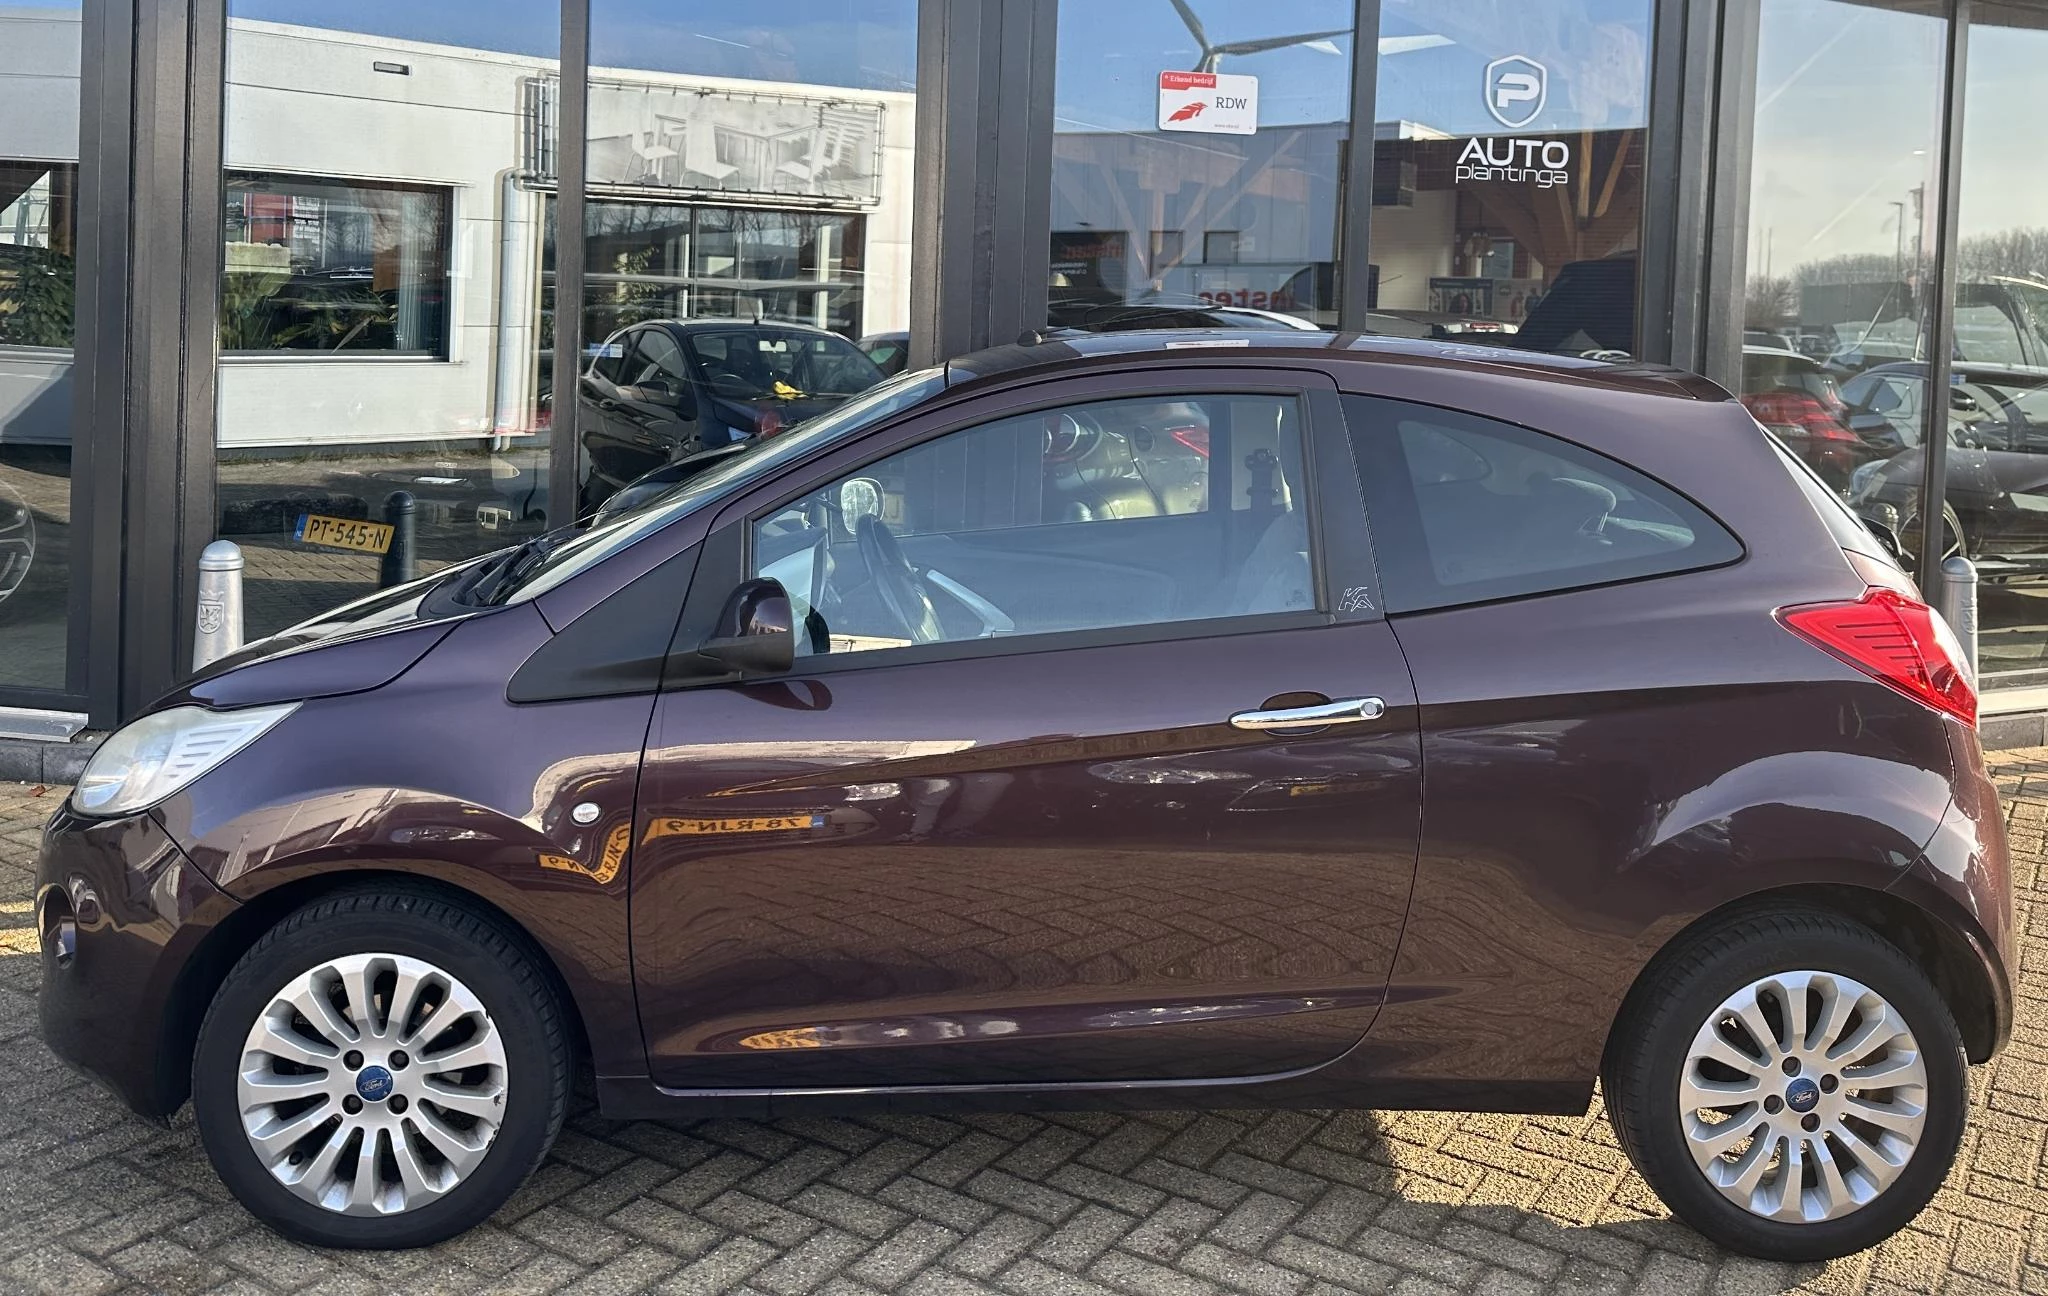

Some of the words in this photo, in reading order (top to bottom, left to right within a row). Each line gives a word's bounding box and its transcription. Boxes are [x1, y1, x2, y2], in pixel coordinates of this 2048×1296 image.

[1169, 75, 1192, 84] Erkend
[1193, 76, 1214, 86] bedrijf
[1497, 73, 1540, 108] P
[1216, 97, 1247, 110] RDW
[1456, 137, 1569, 169] AUTO
[1455, 163, 1569, 188] plantinga
[308, 520, 387, 549] PT-545-N
